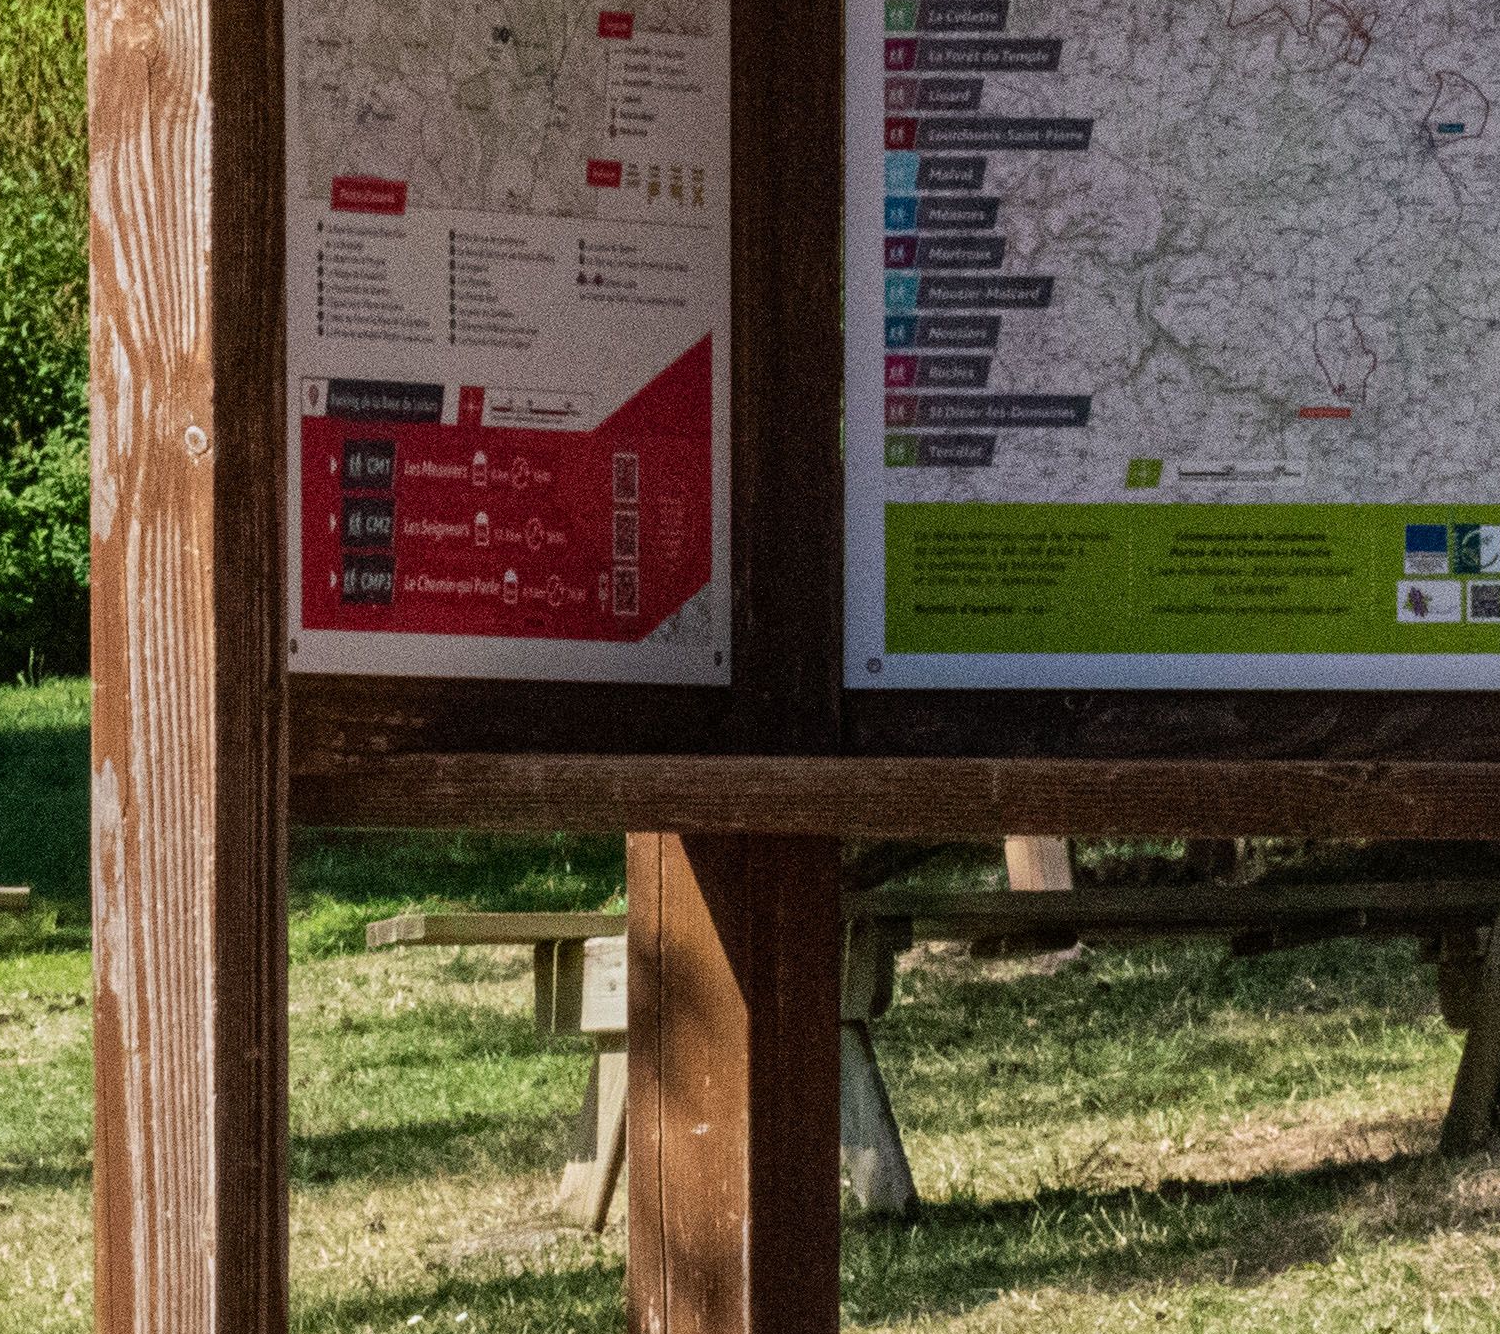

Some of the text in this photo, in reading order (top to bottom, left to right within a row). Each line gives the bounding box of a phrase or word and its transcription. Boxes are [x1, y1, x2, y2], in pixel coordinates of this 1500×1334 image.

[366, 455, 391, 475] CM1
[365, 515, 391, 534] CM2
[360, 572, 392, 591] CMP3
